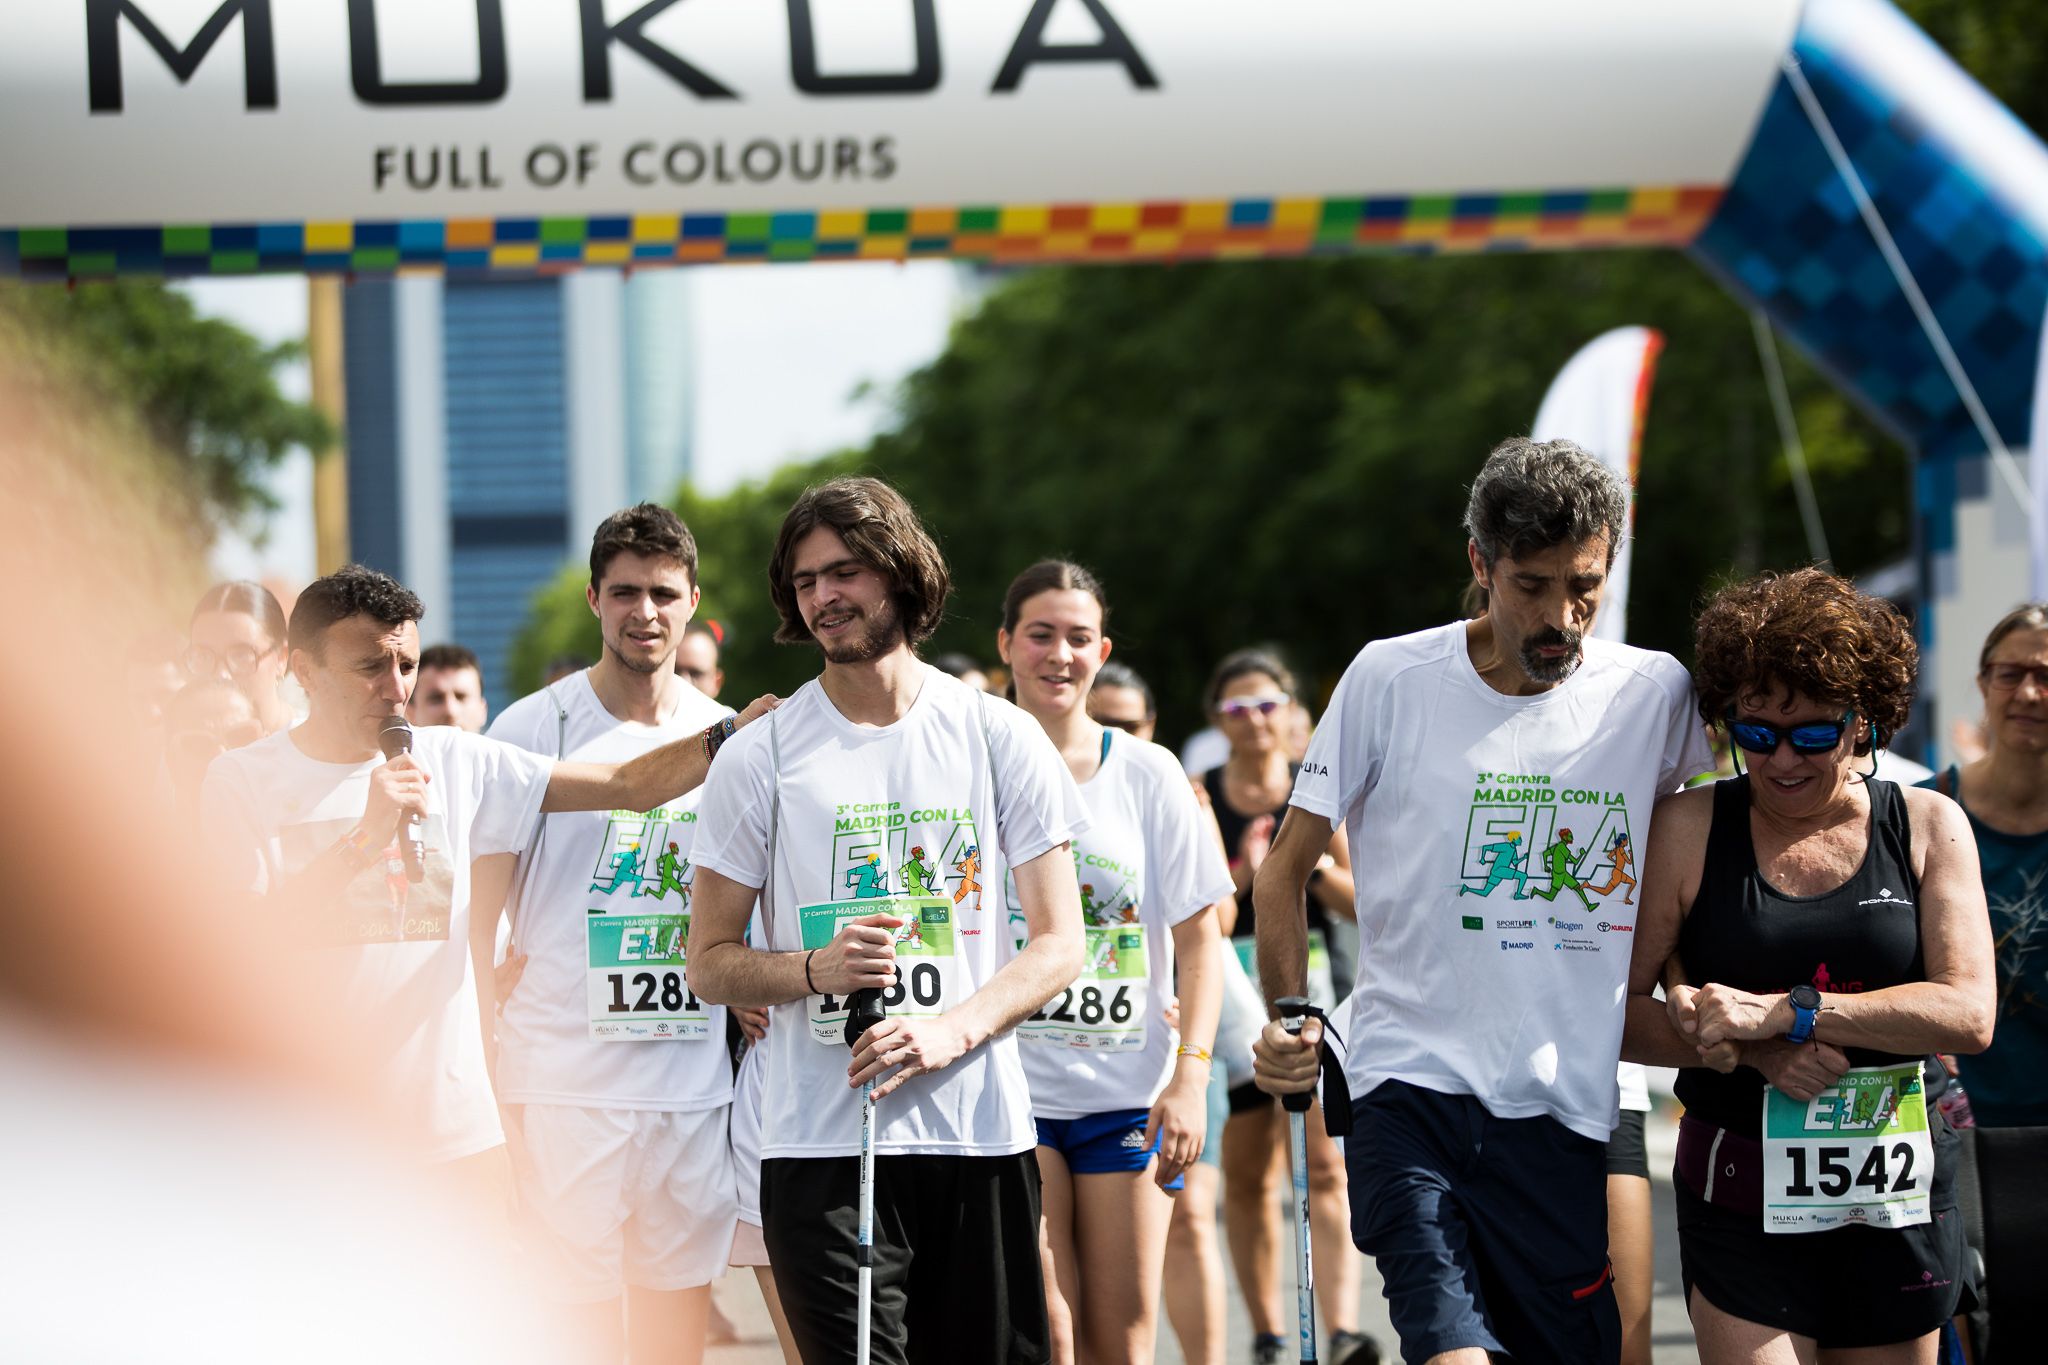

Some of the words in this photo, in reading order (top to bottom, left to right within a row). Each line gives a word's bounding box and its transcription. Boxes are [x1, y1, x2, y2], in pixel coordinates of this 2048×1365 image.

[374, 145, 500, 192] FULL
[525, 142, 601, 188] OF
[621, 136, 900, 186] COLOURS
[1497, 773, 1551, 784] Carrera
[1473, 788, 1556, 803] MADRID
[1561, 789, 1599, 805] CON
[1604, 791, 1625, 806] LA
[853, 802, 900, 813] Carrera
[835, 813, 905, 832] MADRID
[909, 808, 948, 824] CON
[952, 808, 973, 821] LA
[1085, 854, 1120, 872] CON
[811, 909, 834, 917] Carrera
[835, 905, 875, 915] MADRID
[900, 904, 912, 912] LA
[624, 918, 659, 927] MADRID
[1555, 920, 1583, 932] Biogen
[617, 926, 688, 961] ELA
[1838, 1078, 1857, 1086] RID
[1860, 1076, 1881, 1085] CON
[1883, 1075, 1893, 1084] LA
[1803, 1086, 1899, 1131] ELA
[1786, 1143, 1917, 1197] 1542
